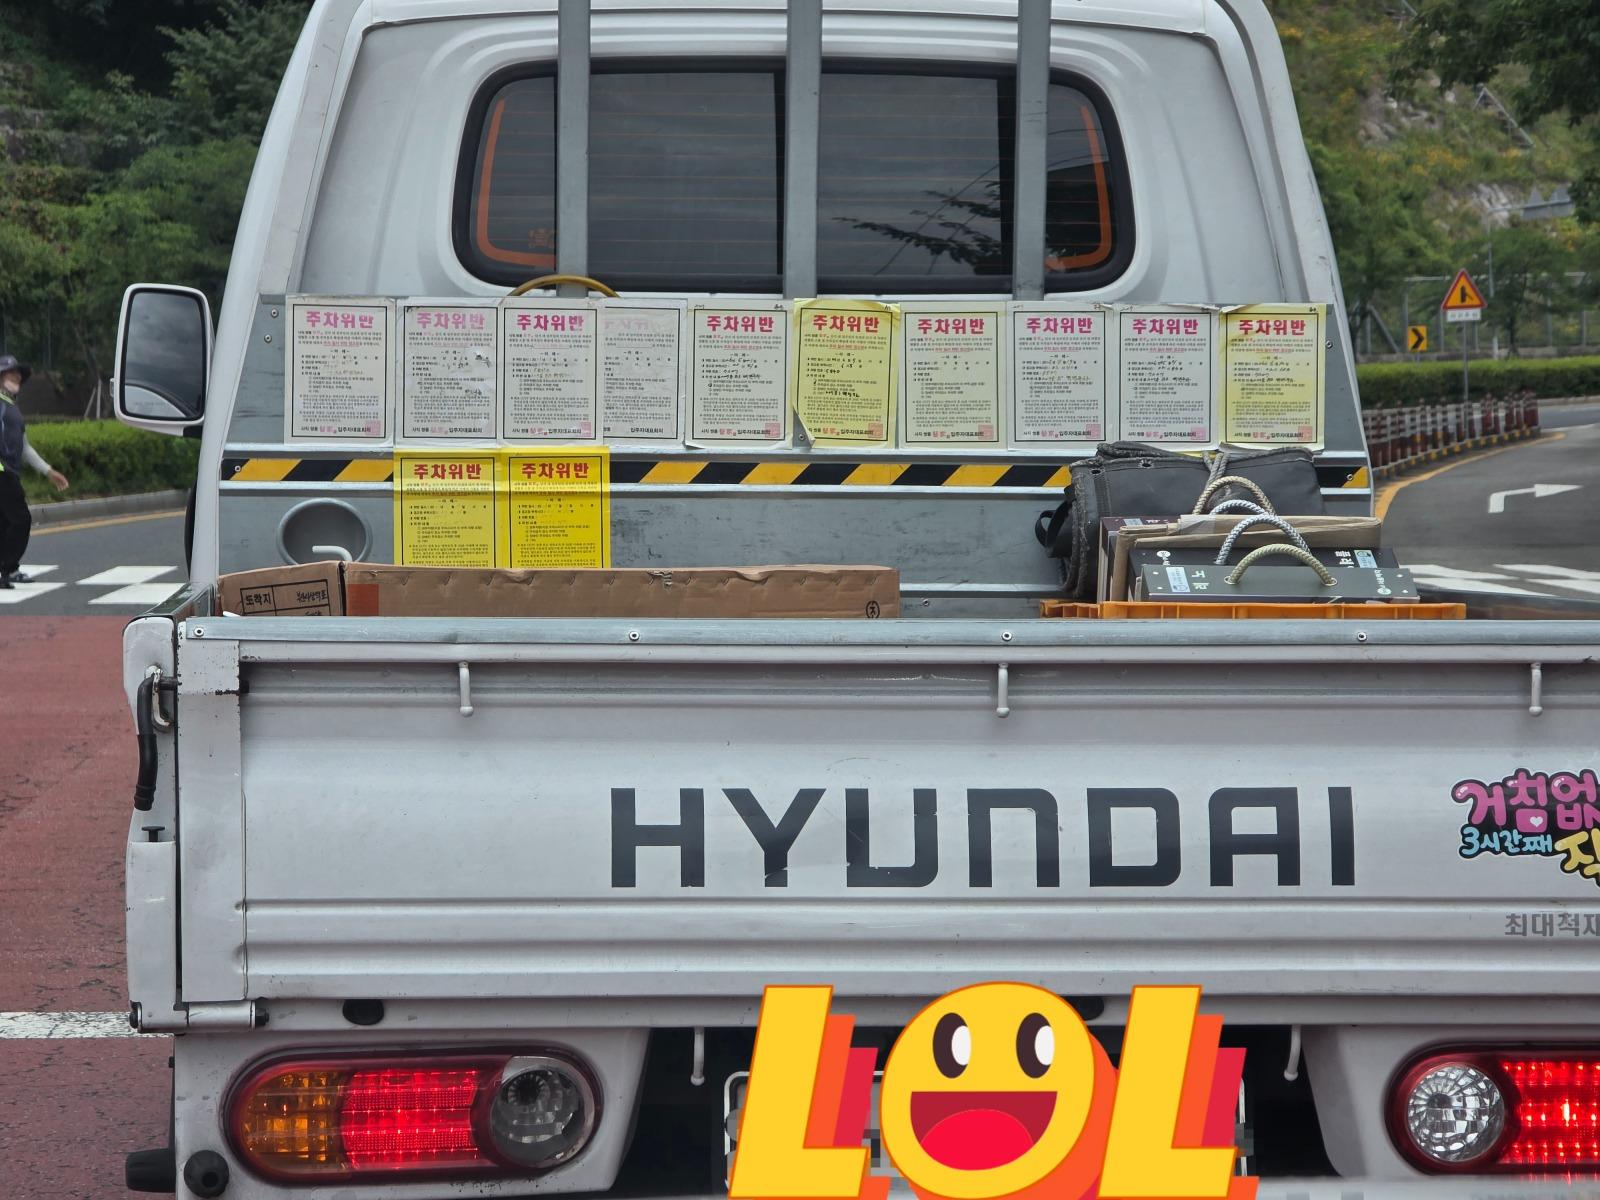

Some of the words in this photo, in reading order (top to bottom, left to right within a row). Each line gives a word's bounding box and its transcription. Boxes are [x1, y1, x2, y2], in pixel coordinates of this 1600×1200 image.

[417, 312, 485, 330] 주차위반
[517, 314, 584, 332] 주차위반
[707, 315, 775, 333] 주차위반
[812, 314, 880, 333] 주차위반
[918, 318, 985, 335] 주차위반
[1026, 317, 1093, 334] 주차위반
[1132, 319, 1199, 335] 주차위반
[1239, 319, 1306, 336] 주차위반
[413, 463, 482, 480] 주차위반
[521, 462, 589, 480] 주차위반
[610, 786, 1356, 888] HYUNDAI
[1461, 826, 1553, 856] 3시간째
